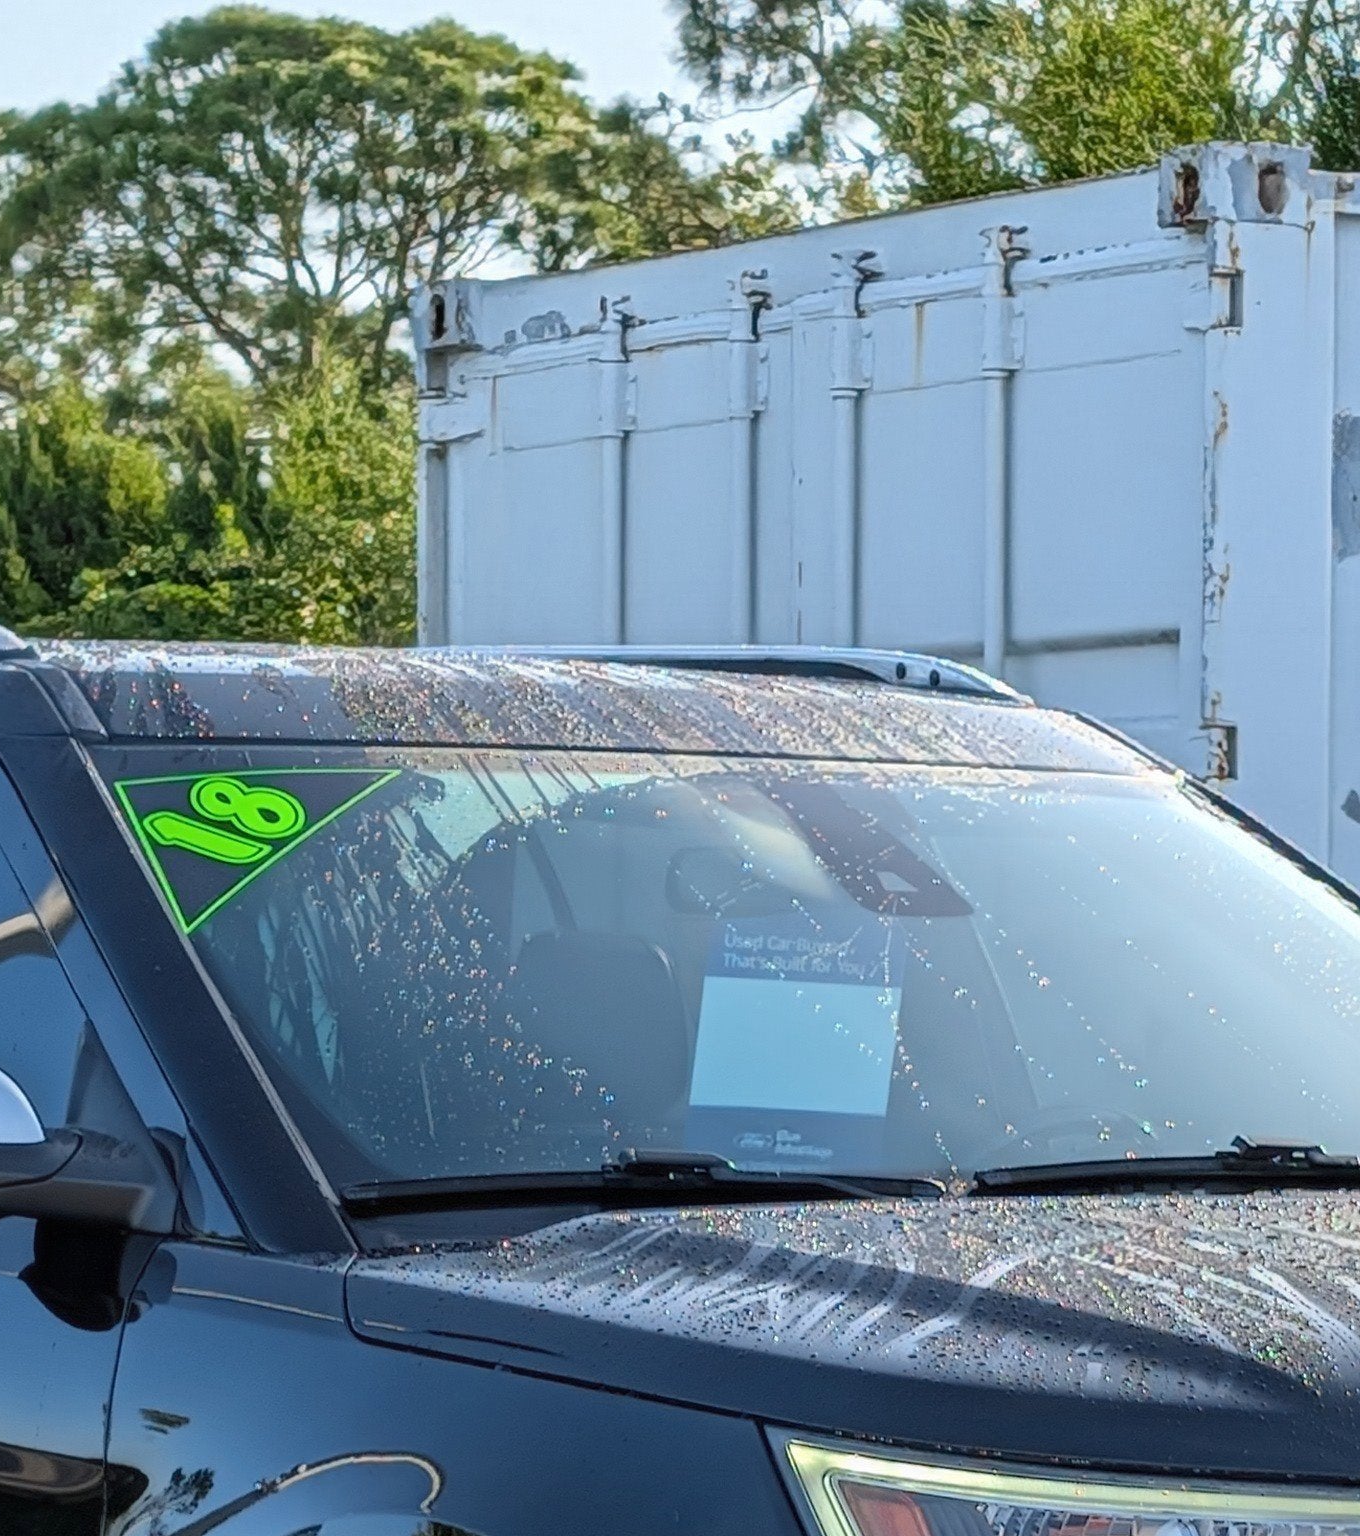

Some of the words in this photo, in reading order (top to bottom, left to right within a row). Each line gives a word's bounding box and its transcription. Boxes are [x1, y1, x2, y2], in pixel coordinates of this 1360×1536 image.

[142, 775, 306, 865] 18
[724, 932, 763, 949] Used
[767, 935, 793, 951] Car
